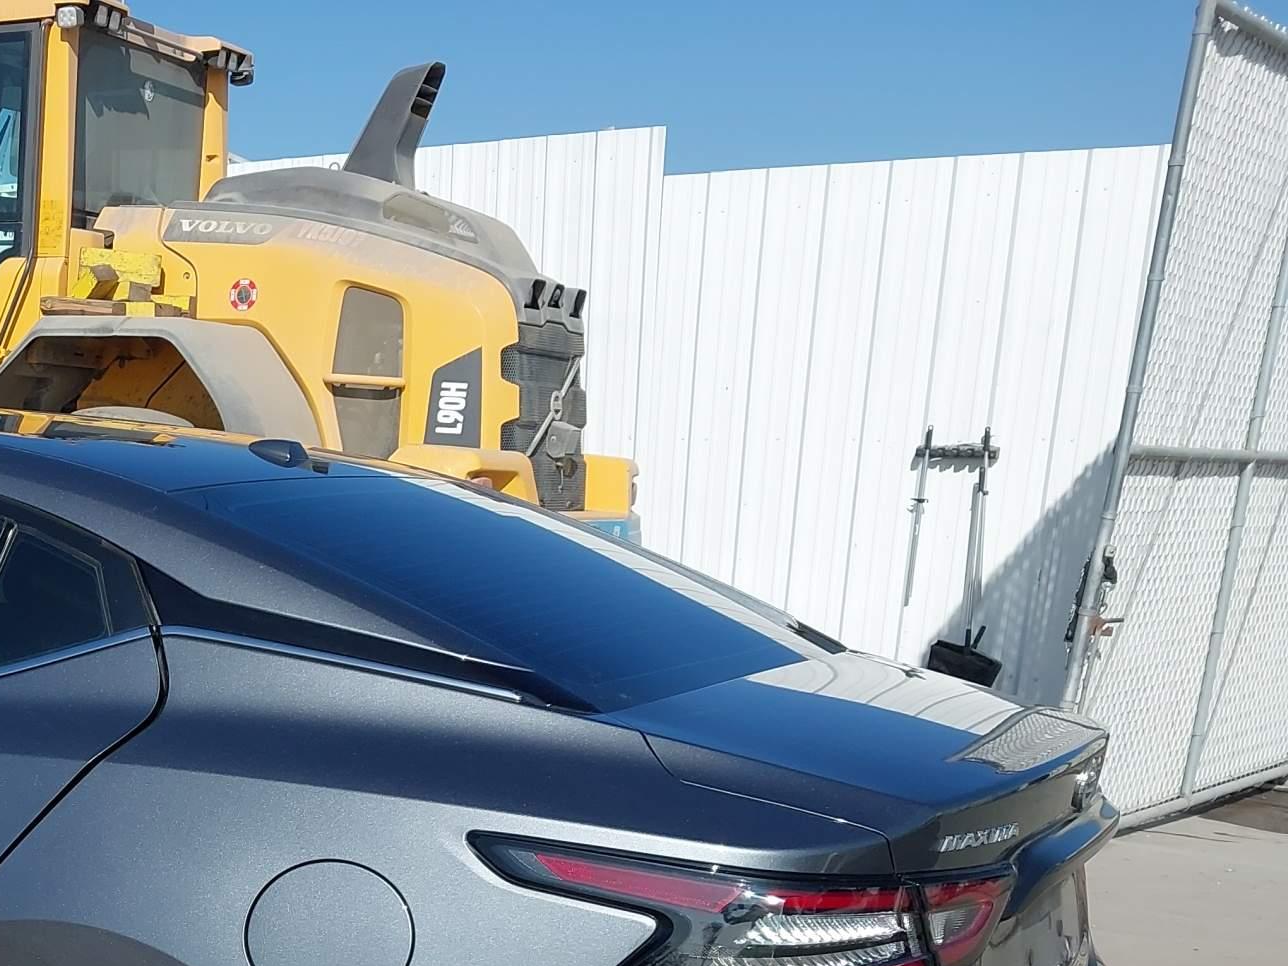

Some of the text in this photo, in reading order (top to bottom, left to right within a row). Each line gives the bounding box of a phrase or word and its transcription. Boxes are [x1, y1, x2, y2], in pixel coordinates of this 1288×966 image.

[179, 219, 273, 235] VOLVO
[435, 381, 469, 435] L90H
[938, 822, 1019, 853] MAXIMA
